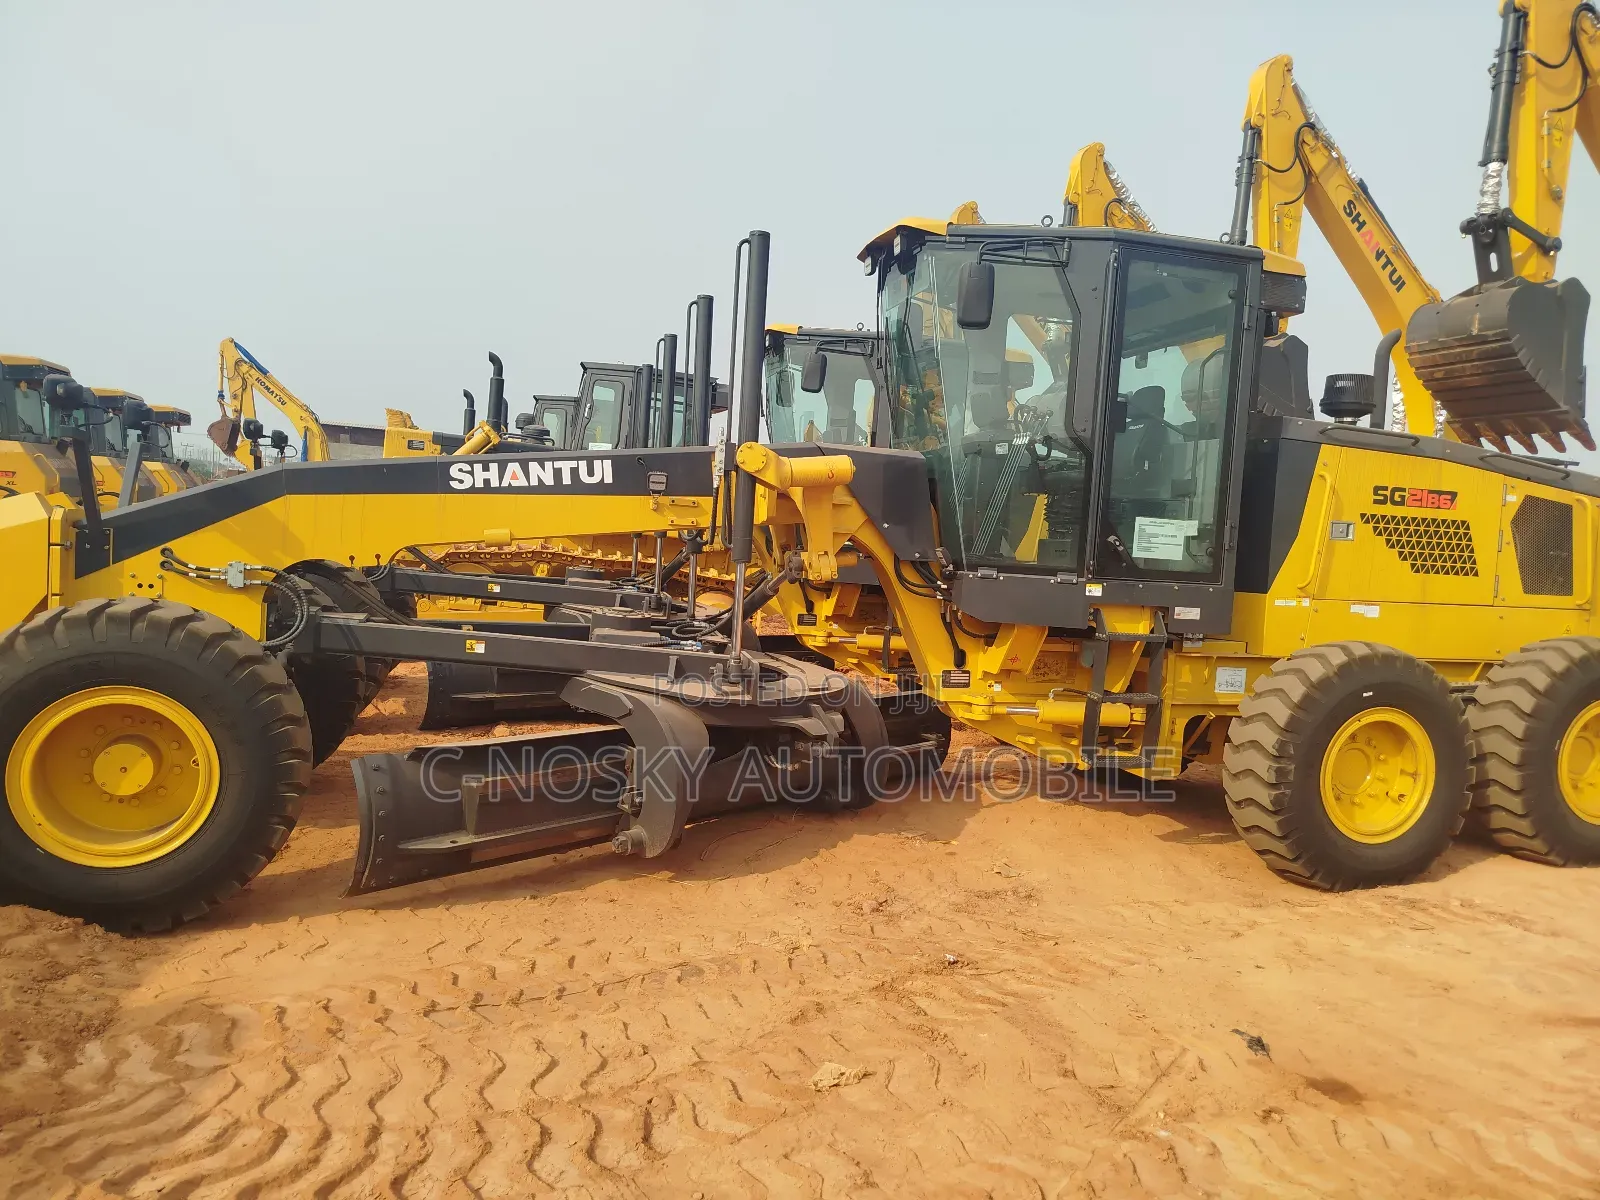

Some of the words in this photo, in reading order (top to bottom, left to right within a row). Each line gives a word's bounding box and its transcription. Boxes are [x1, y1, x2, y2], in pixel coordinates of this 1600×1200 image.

[1342, 199, 1407, 294] SHANTUI
[255, 376, 287, 406] KOMATSU
[448, 459, 614, 490] SHANTUI
